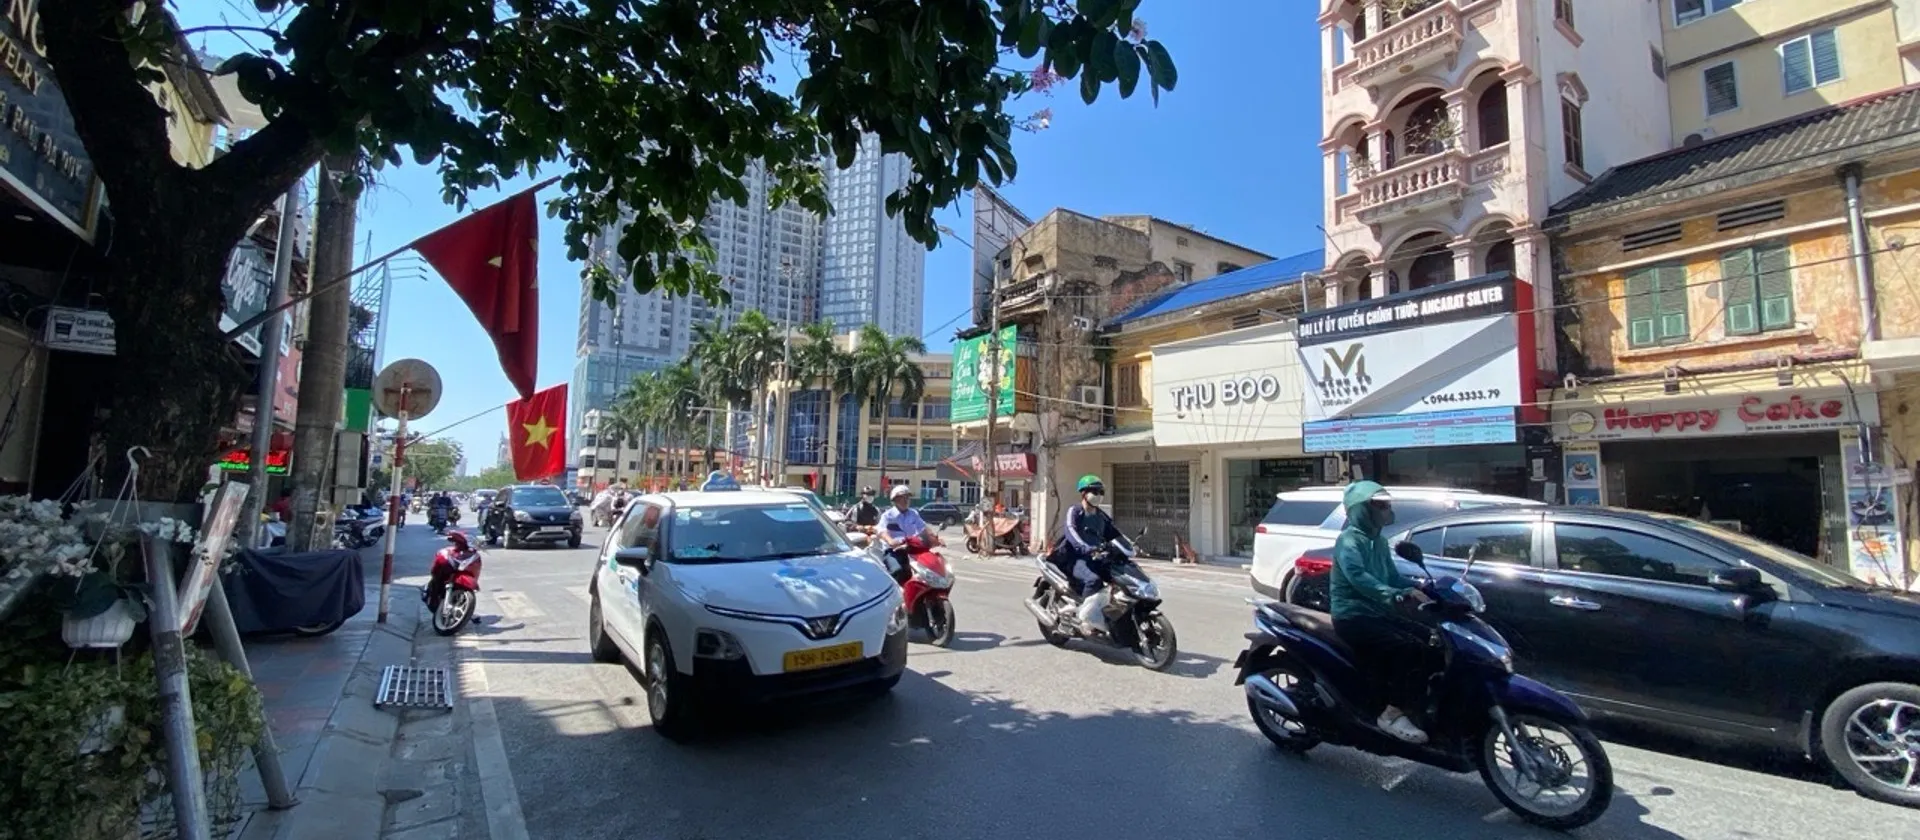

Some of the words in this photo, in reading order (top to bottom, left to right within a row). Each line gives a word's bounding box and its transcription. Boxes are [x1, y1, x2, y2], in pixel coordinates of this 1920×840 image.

[1466, 286, 1503, 307] SILVER
[1170, 382, 1215, 410] THU
[1220, 374, 1280, 407] BOO
[1603, 407, 1720, 434] Happy
[1737, 394, 1844, 423] Cake
